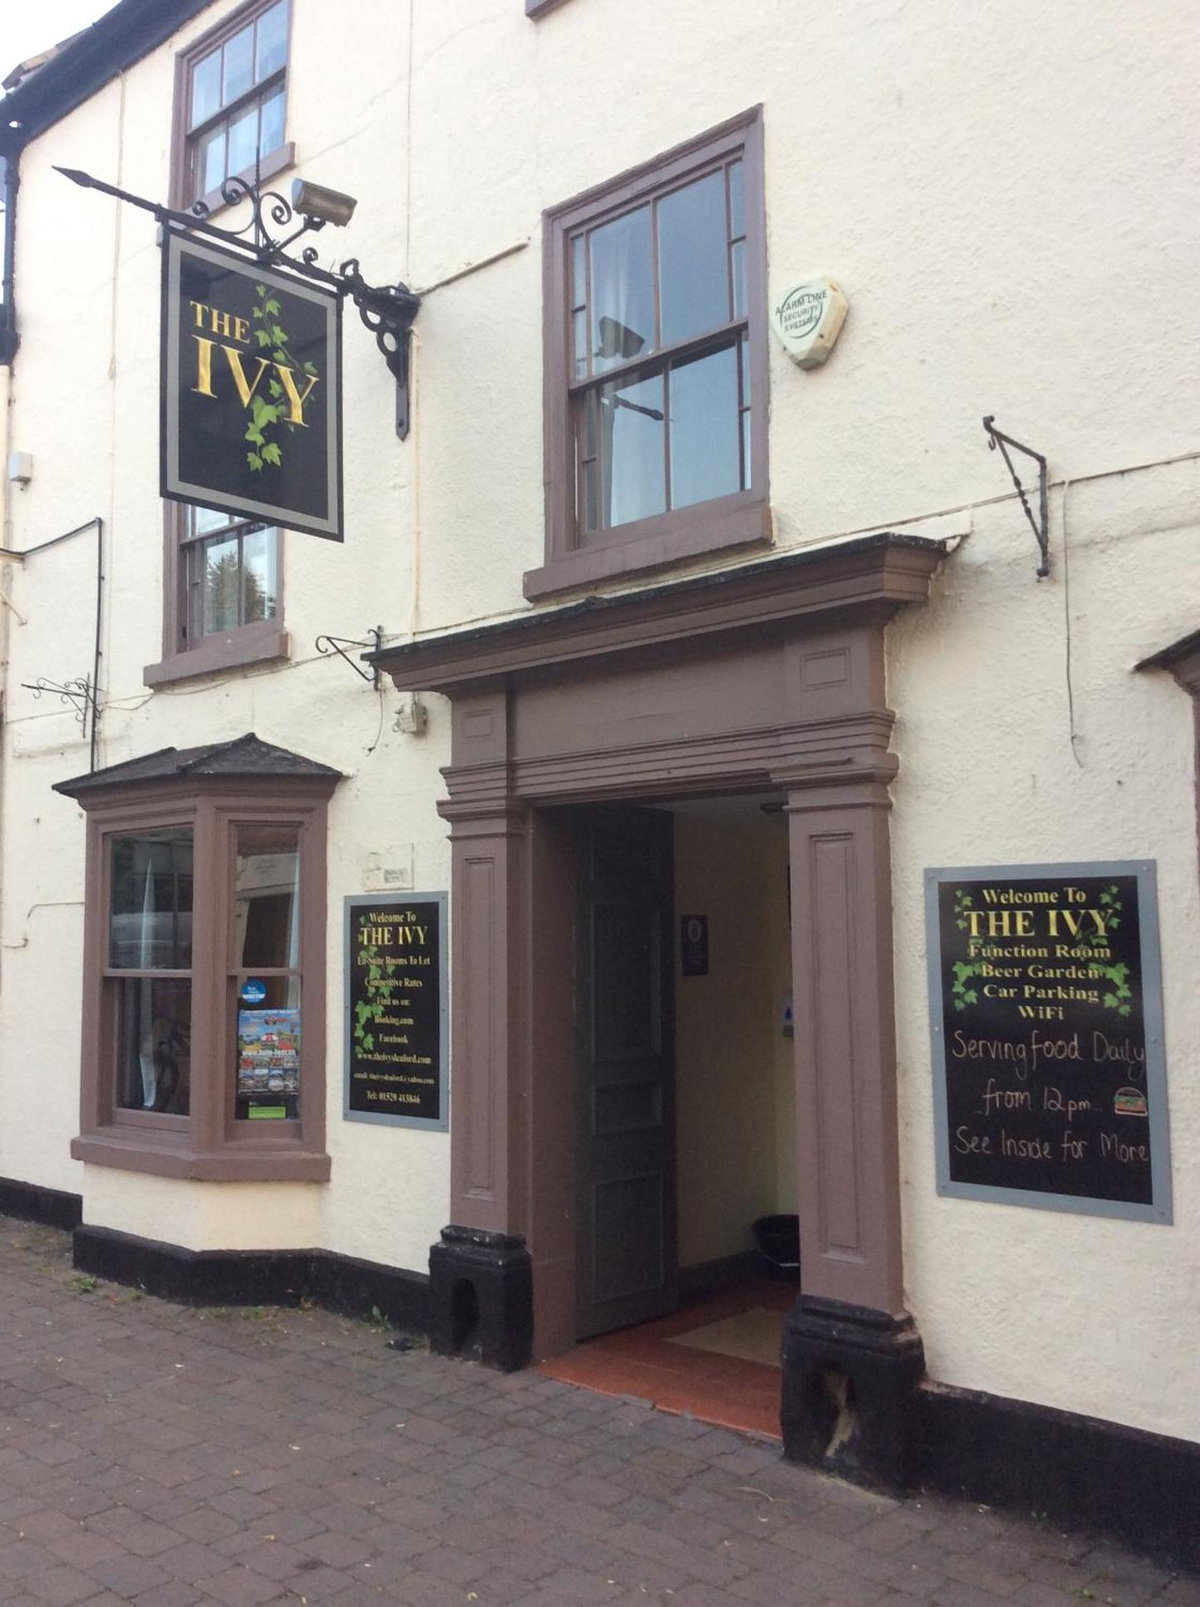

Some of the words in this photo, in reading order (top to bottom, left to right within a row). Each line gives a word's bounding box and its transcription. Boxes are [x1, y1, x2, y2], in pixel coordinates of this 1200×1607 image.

[775, 298, 805, 316] ALARM
[807, 289, 828, 304] LINE
[189, 300, 250, 344] THE
[783, 305, 819, 323] SECURITY
[190, 334, 320, 428] IVY
[982, 888, 1059, 905] Welcome
[1064, 886, 1087, 904] To
[369, 912, 404, 923] Welcome
[406, 911, 417, 922] To
[963, 909, 1036, 937] THE
[1047, 908, 1114, 937] IVY
[361, 926, 393, 945] THE
[398, 926, 428, 945] IVY
[385, 956, 408, 966] Rooms
[409, 955, 418, 966] To
[418, 955, 431, 966] Let
[968, 943, 1049, 958] Function
[1055, 944, 1112, 959] Room
[981, 964, 1023, 979] Beer
[1027, 964, 1100, 980] Garden
[404, 977, 424, 987] Rates
[983, 984, 1018, 998] Car
[1023, 984, 1100, 1004] Parking
[1017, 1005, 1065, 1020] WiFi
[952, 1029, 1028, 1080] Serving
[1030, 1029, 1084, 1071] food
[1092, 1031, 1146, 1081] Daily
[975, 1078, 1032, 1116] from
[953, 1125, 992, 1154] See
[1002, 1128, 1053, 1160] Inside
[1060, 1130, 1089, 1162] for
[1099, 1132, 1149, 1163] More
